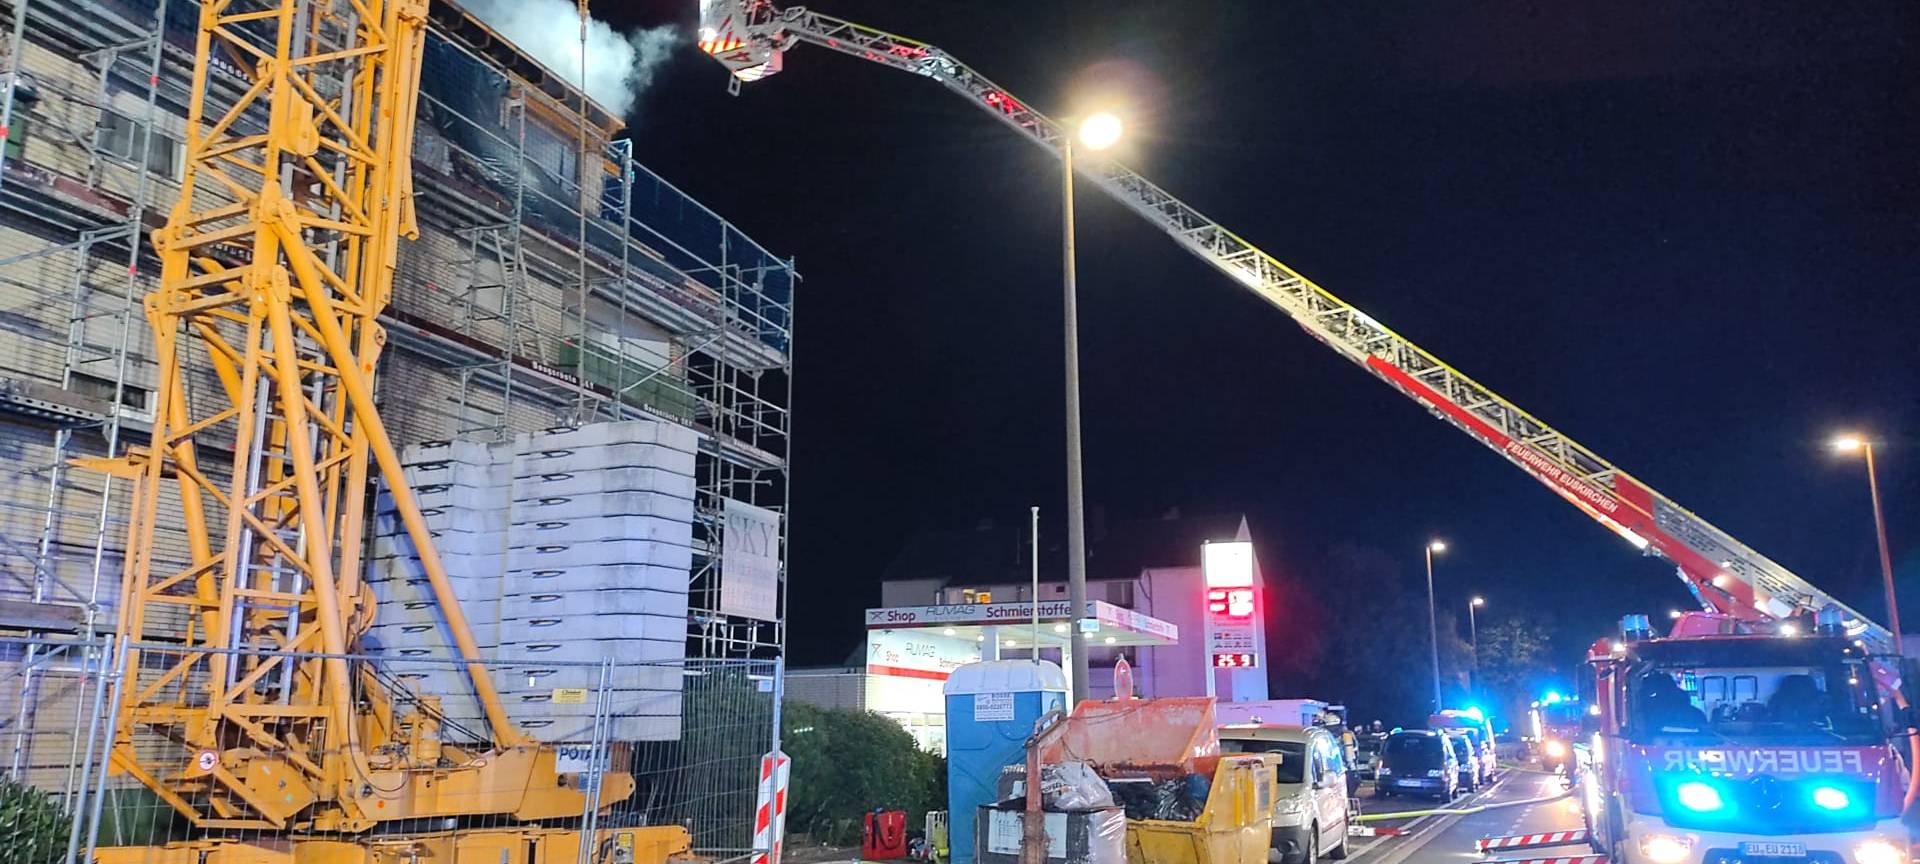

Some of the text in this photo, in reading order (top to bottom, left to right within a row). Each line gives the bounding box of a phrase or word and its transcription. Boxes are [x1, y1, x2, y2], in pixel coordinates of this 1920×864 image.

[1507, 441, 1618, 512] FEUERWEHR EUSKIRCHEN
[728, 512, 775, 557] SKY
[887, 611, 916, 623] Shop
